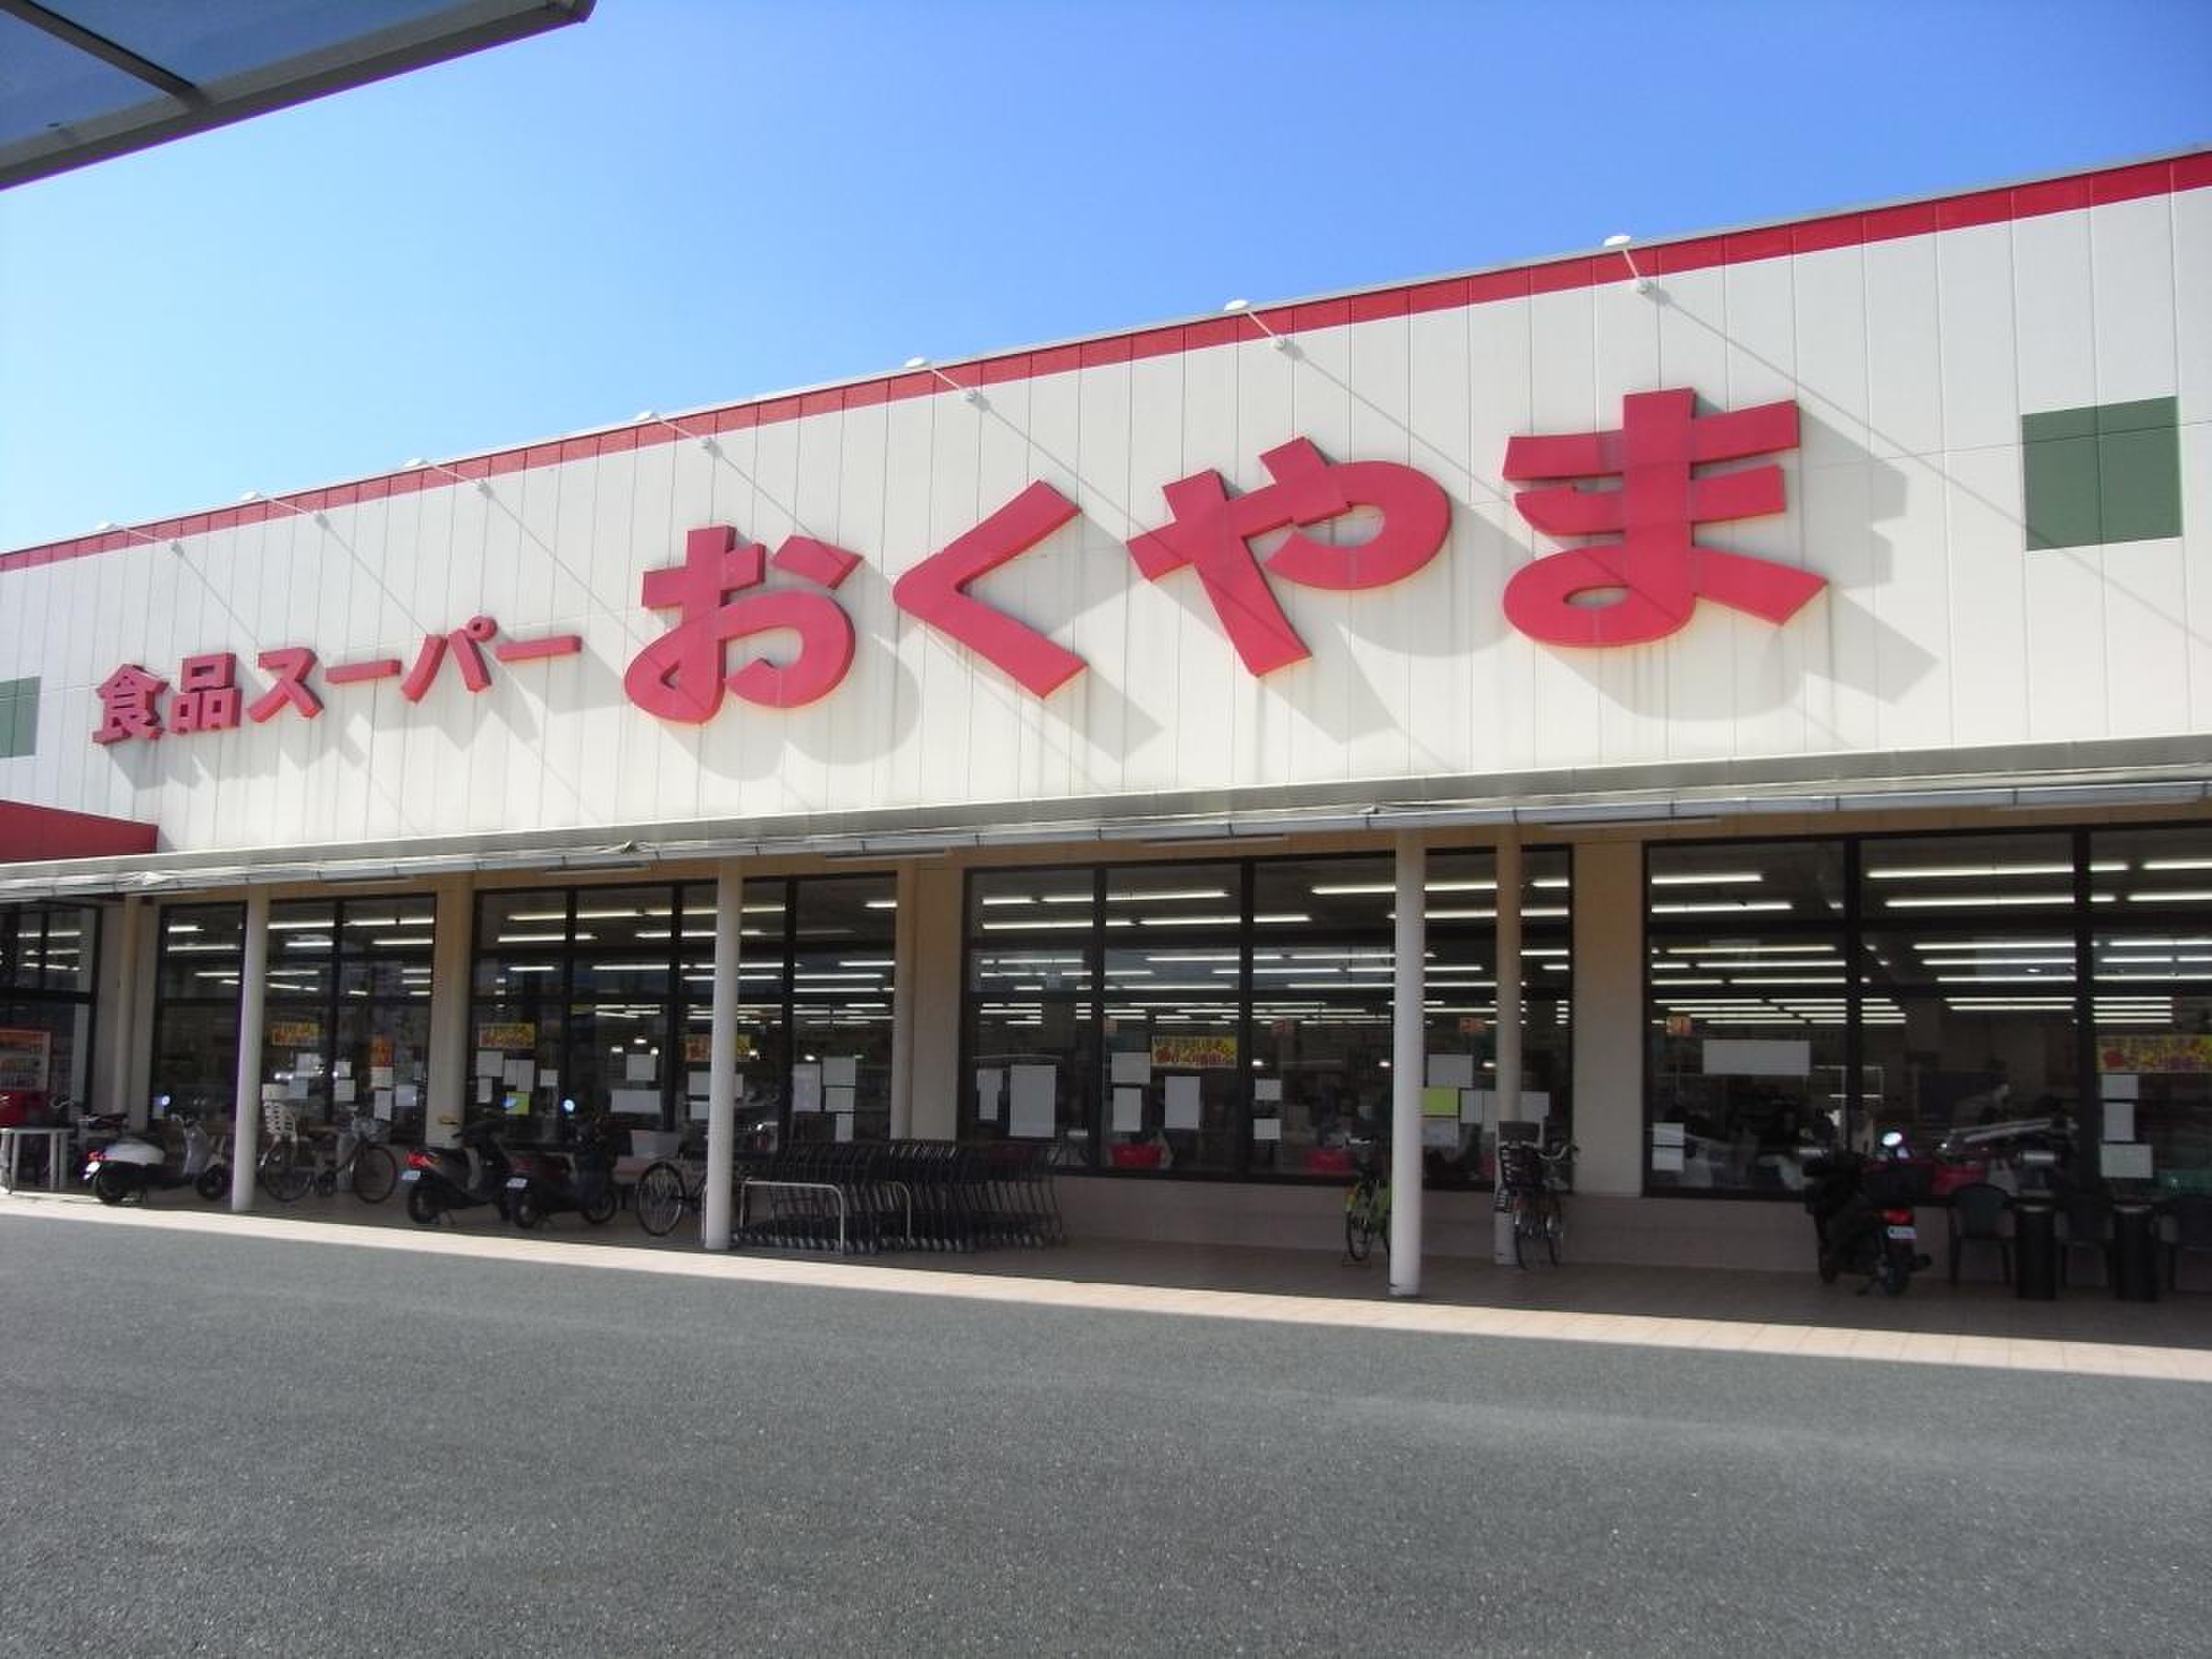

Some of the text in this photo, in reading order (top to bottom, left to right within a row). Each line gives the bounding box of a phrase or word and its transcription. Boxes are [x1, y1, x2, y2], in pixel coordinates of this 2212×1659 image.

[93, 388, 1827, 745] 食品スーパー おくやま
